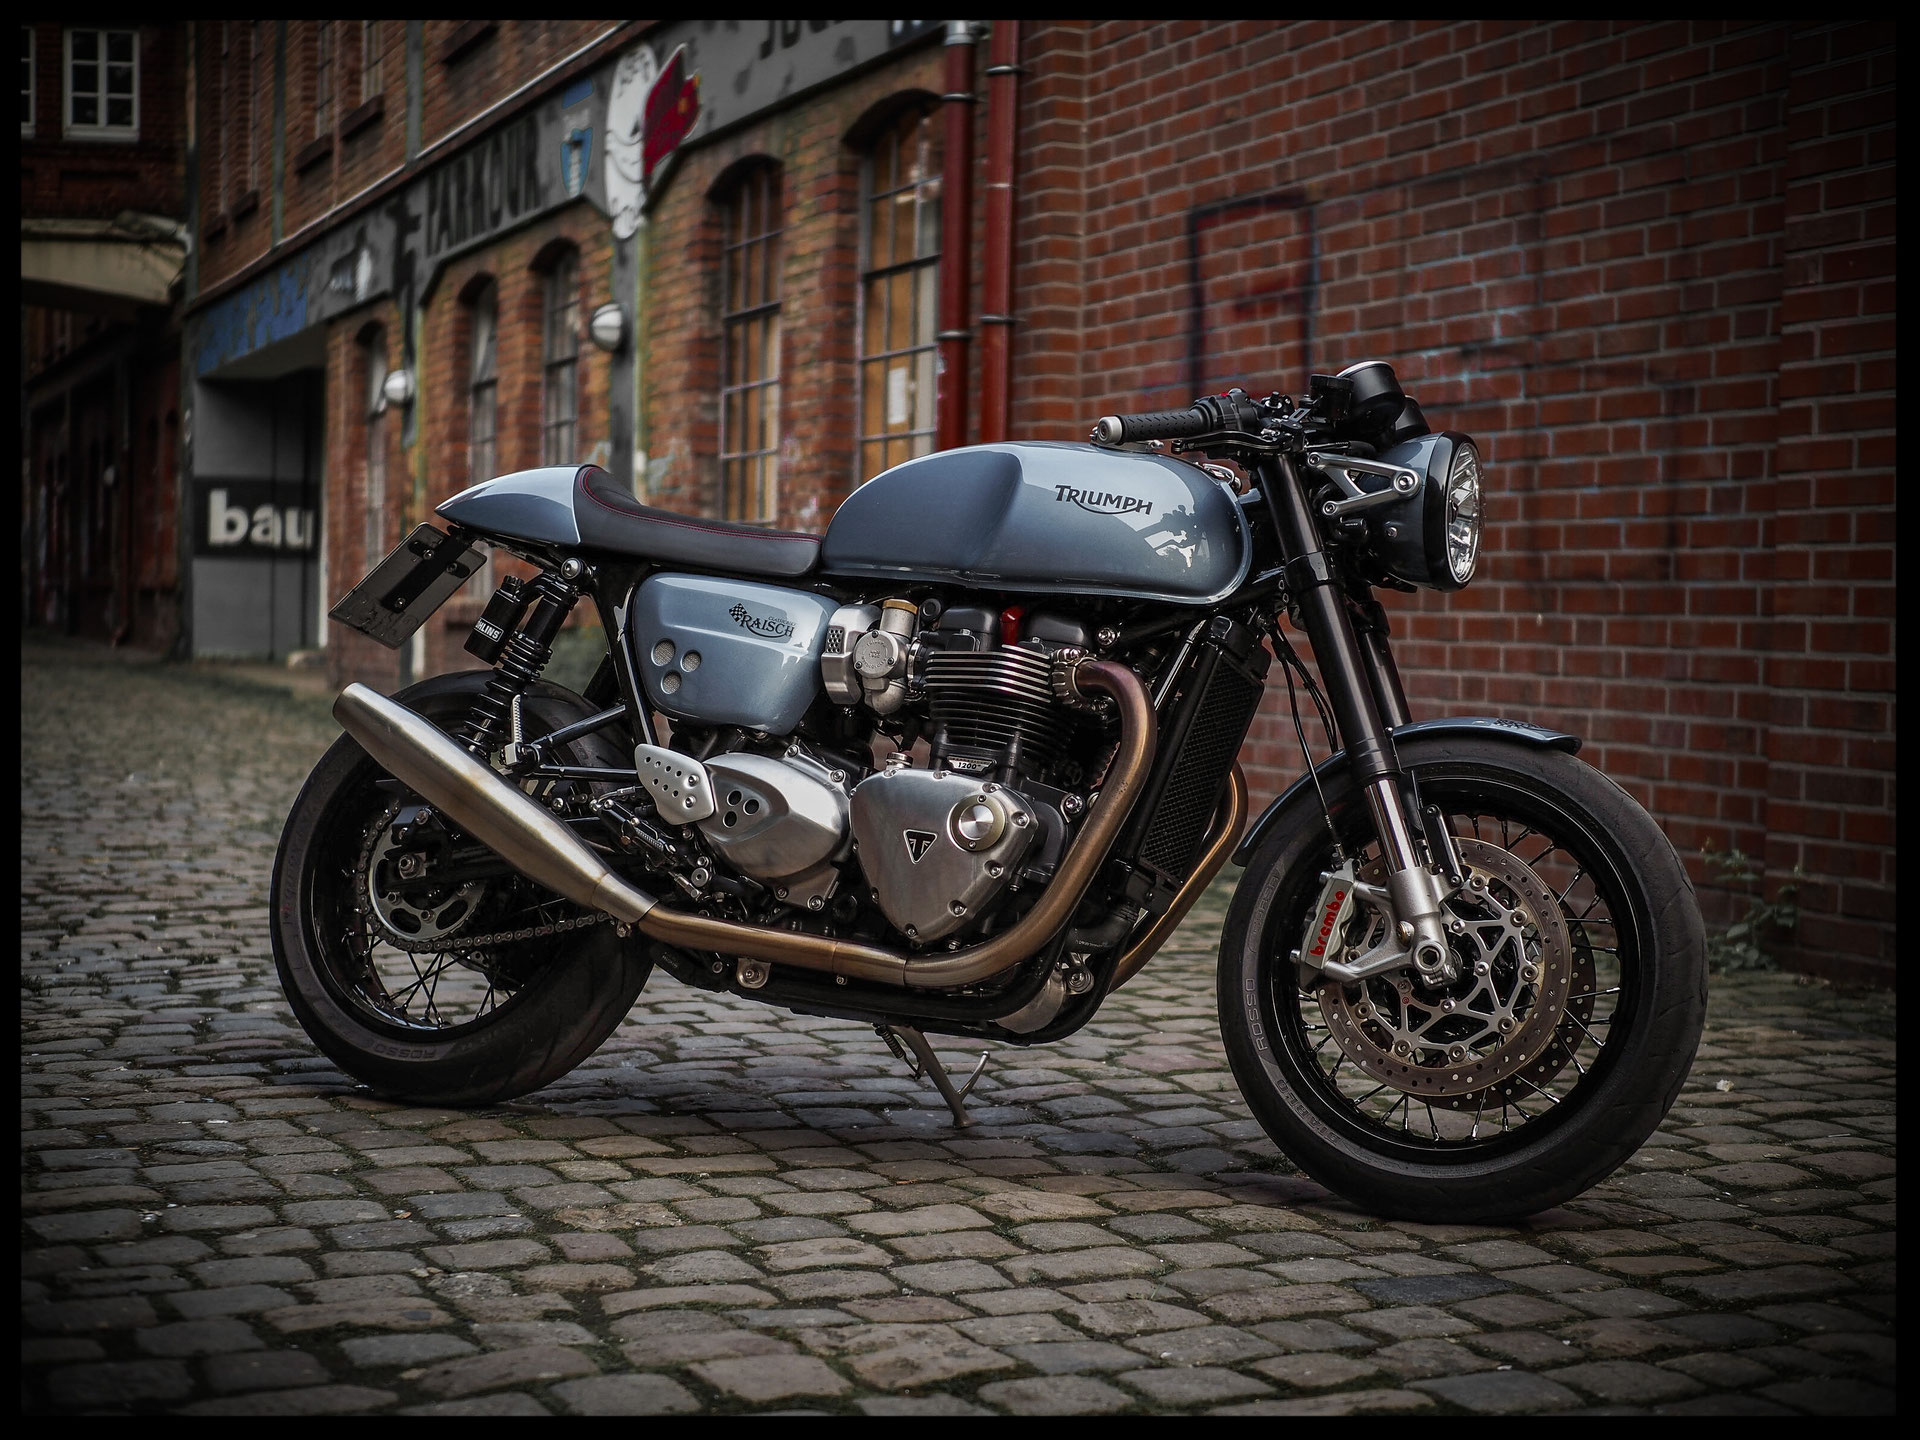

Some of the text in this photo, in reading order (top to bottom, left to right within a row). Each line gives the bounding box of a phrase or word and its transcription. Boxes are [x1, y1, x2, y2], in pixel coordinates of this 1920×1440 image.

[209, 488, 314, 549] bau
[1055, 485, 1153, 515] TRIUMPH
[739, 614, 795, 638] RAISCH
[1309, 890, 1346, 956] brembo
[1245, 978, 1269, 1052] ROSSO
[1276, 1079, 1341, 1147] DIABLO
